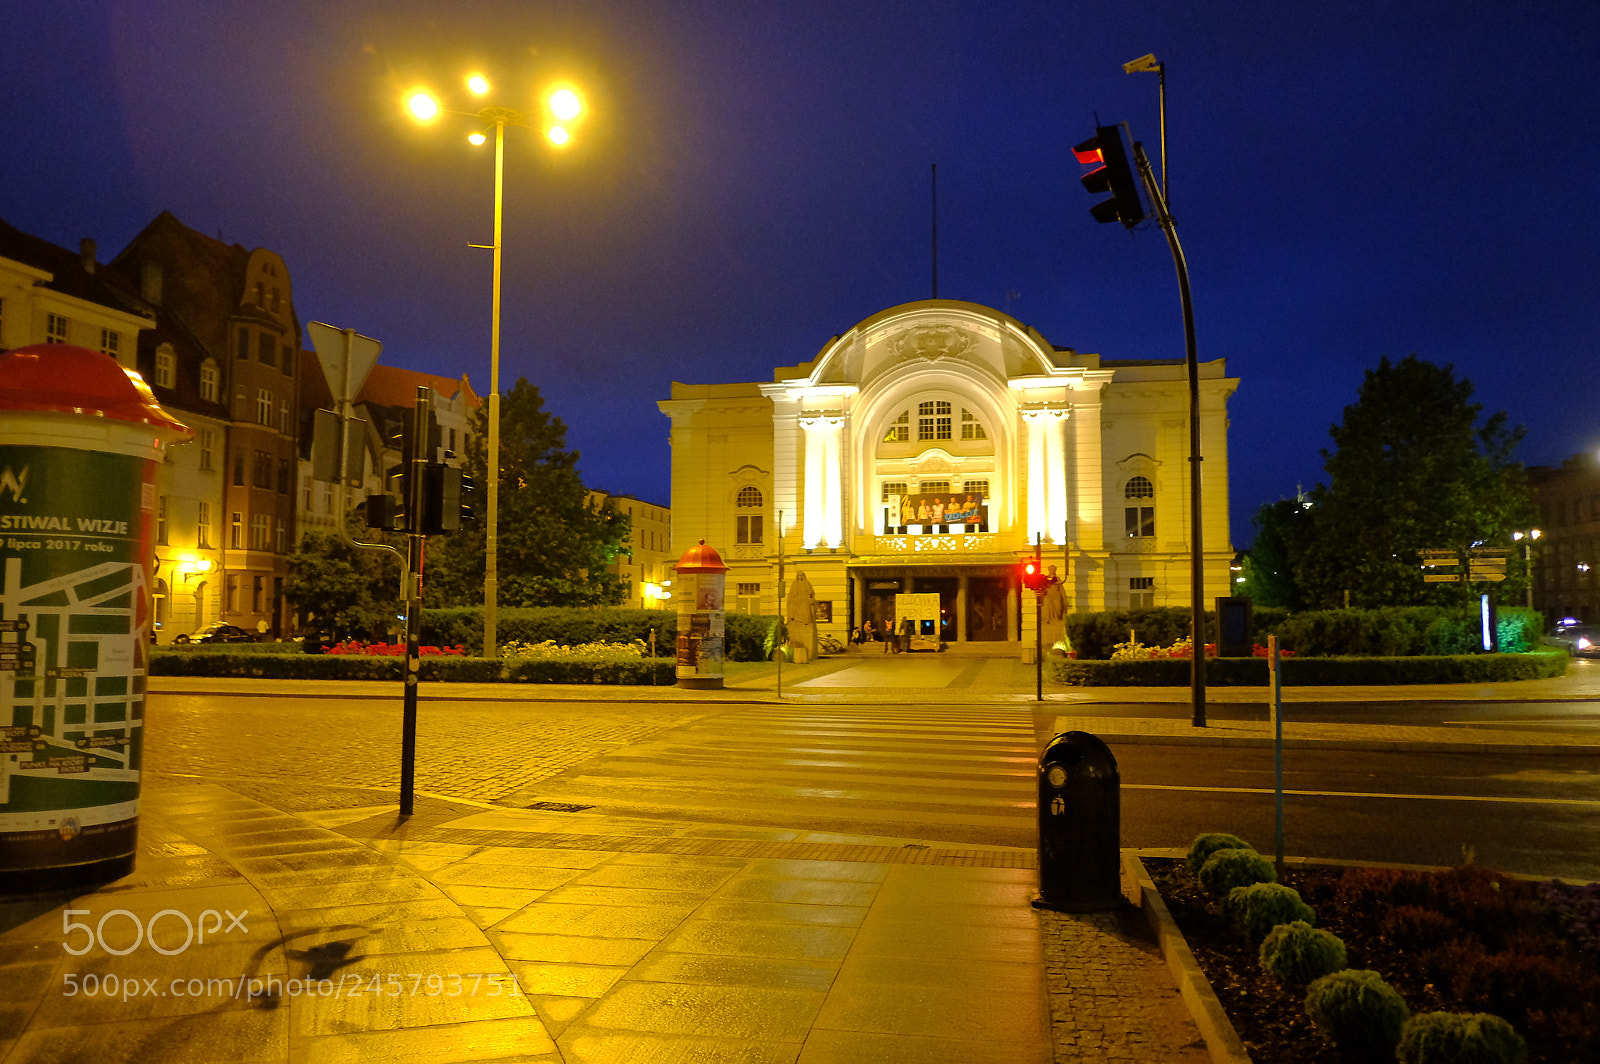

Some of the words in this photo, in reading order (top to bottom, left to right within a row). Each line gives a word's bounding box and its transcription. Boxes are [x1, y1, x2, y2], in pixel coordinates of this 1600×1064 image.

[76, 517, 128, 535] WIZJE
[7, 538, 41, 551] lipca
[46, 538, 81, 550] 2017
[85, 541, 114, 553] roku
